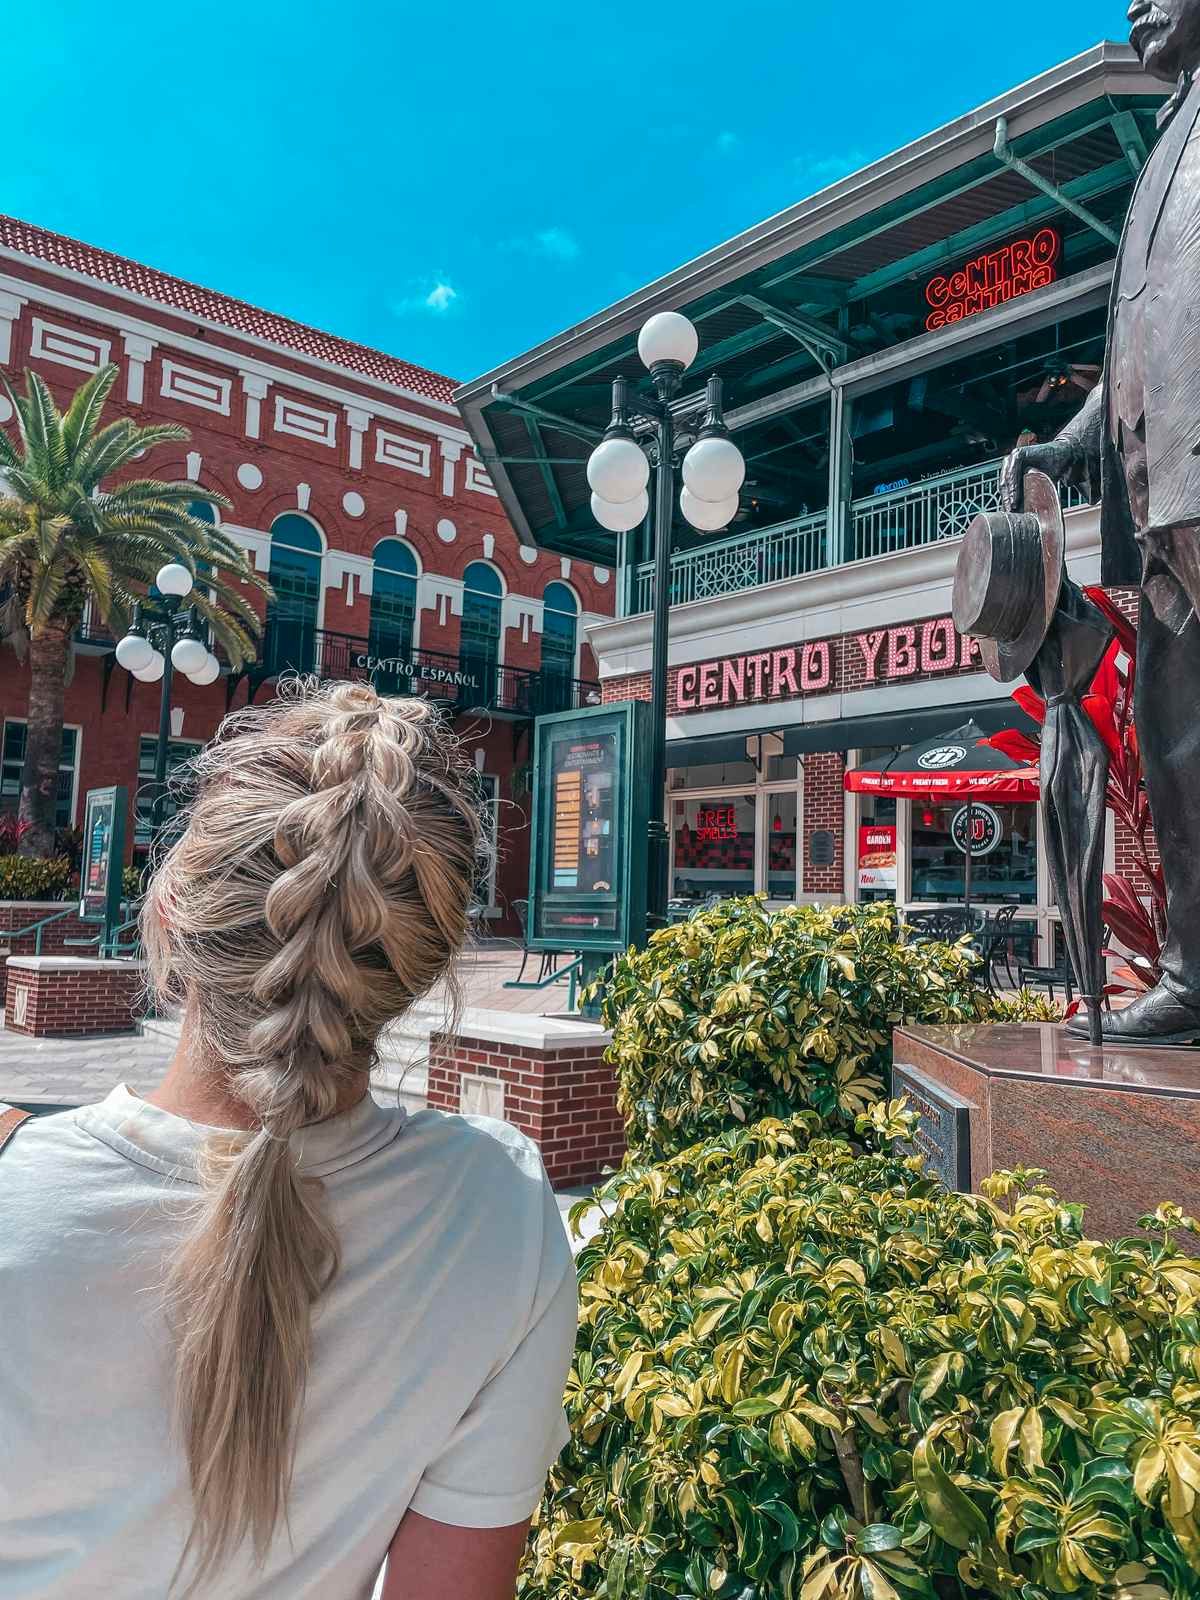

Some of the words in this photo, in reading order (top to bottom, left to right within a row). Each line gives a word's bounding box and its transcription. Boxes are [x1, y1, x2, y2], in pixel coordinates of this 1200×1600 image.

[356, 655, 414, 677] CENTRO
[421, 667, 480, 688] ESPAÑOL
[676, 641, 831, 708] CENTRO
[696, 808, 737, 826] FREE
[696, 825, 737, 839] SMELLS
[866, 835, 891, 845] GARDEN
